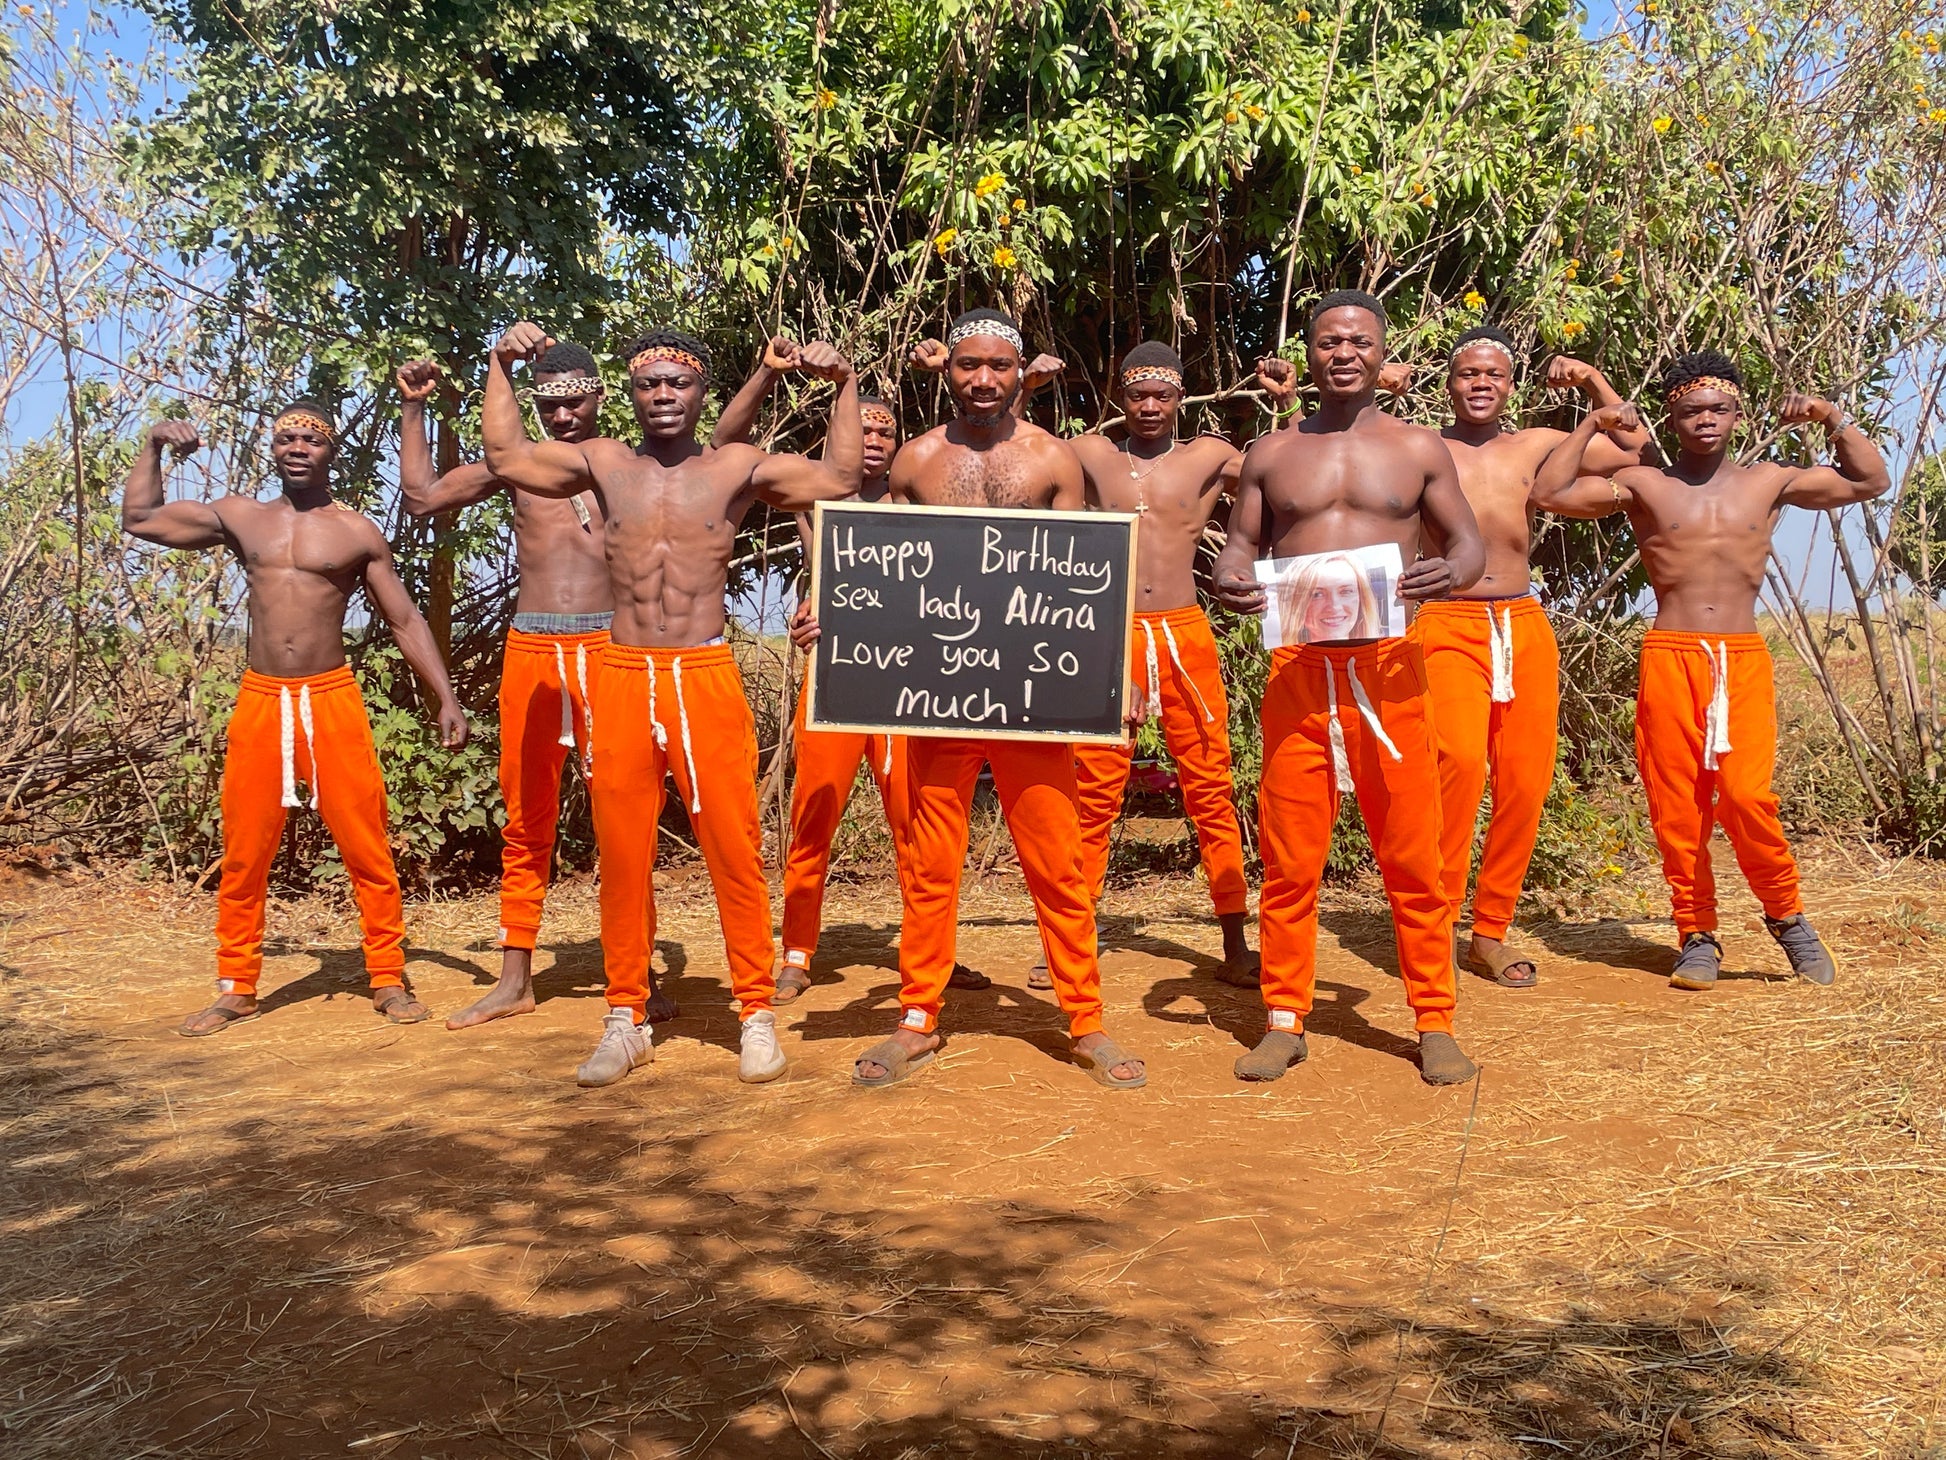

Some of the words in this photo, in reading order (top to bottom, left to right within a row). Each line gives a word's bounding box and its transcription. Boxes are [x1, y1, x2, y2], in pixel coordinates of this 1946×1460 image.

[832, 524, 934, 582] Happy
[980, 524, 1112, 595] Birthday
[1004, 585, 1096, 632] Alina
[830, 634, 914, 670] Love
[940, 643, 1001, 676] you
